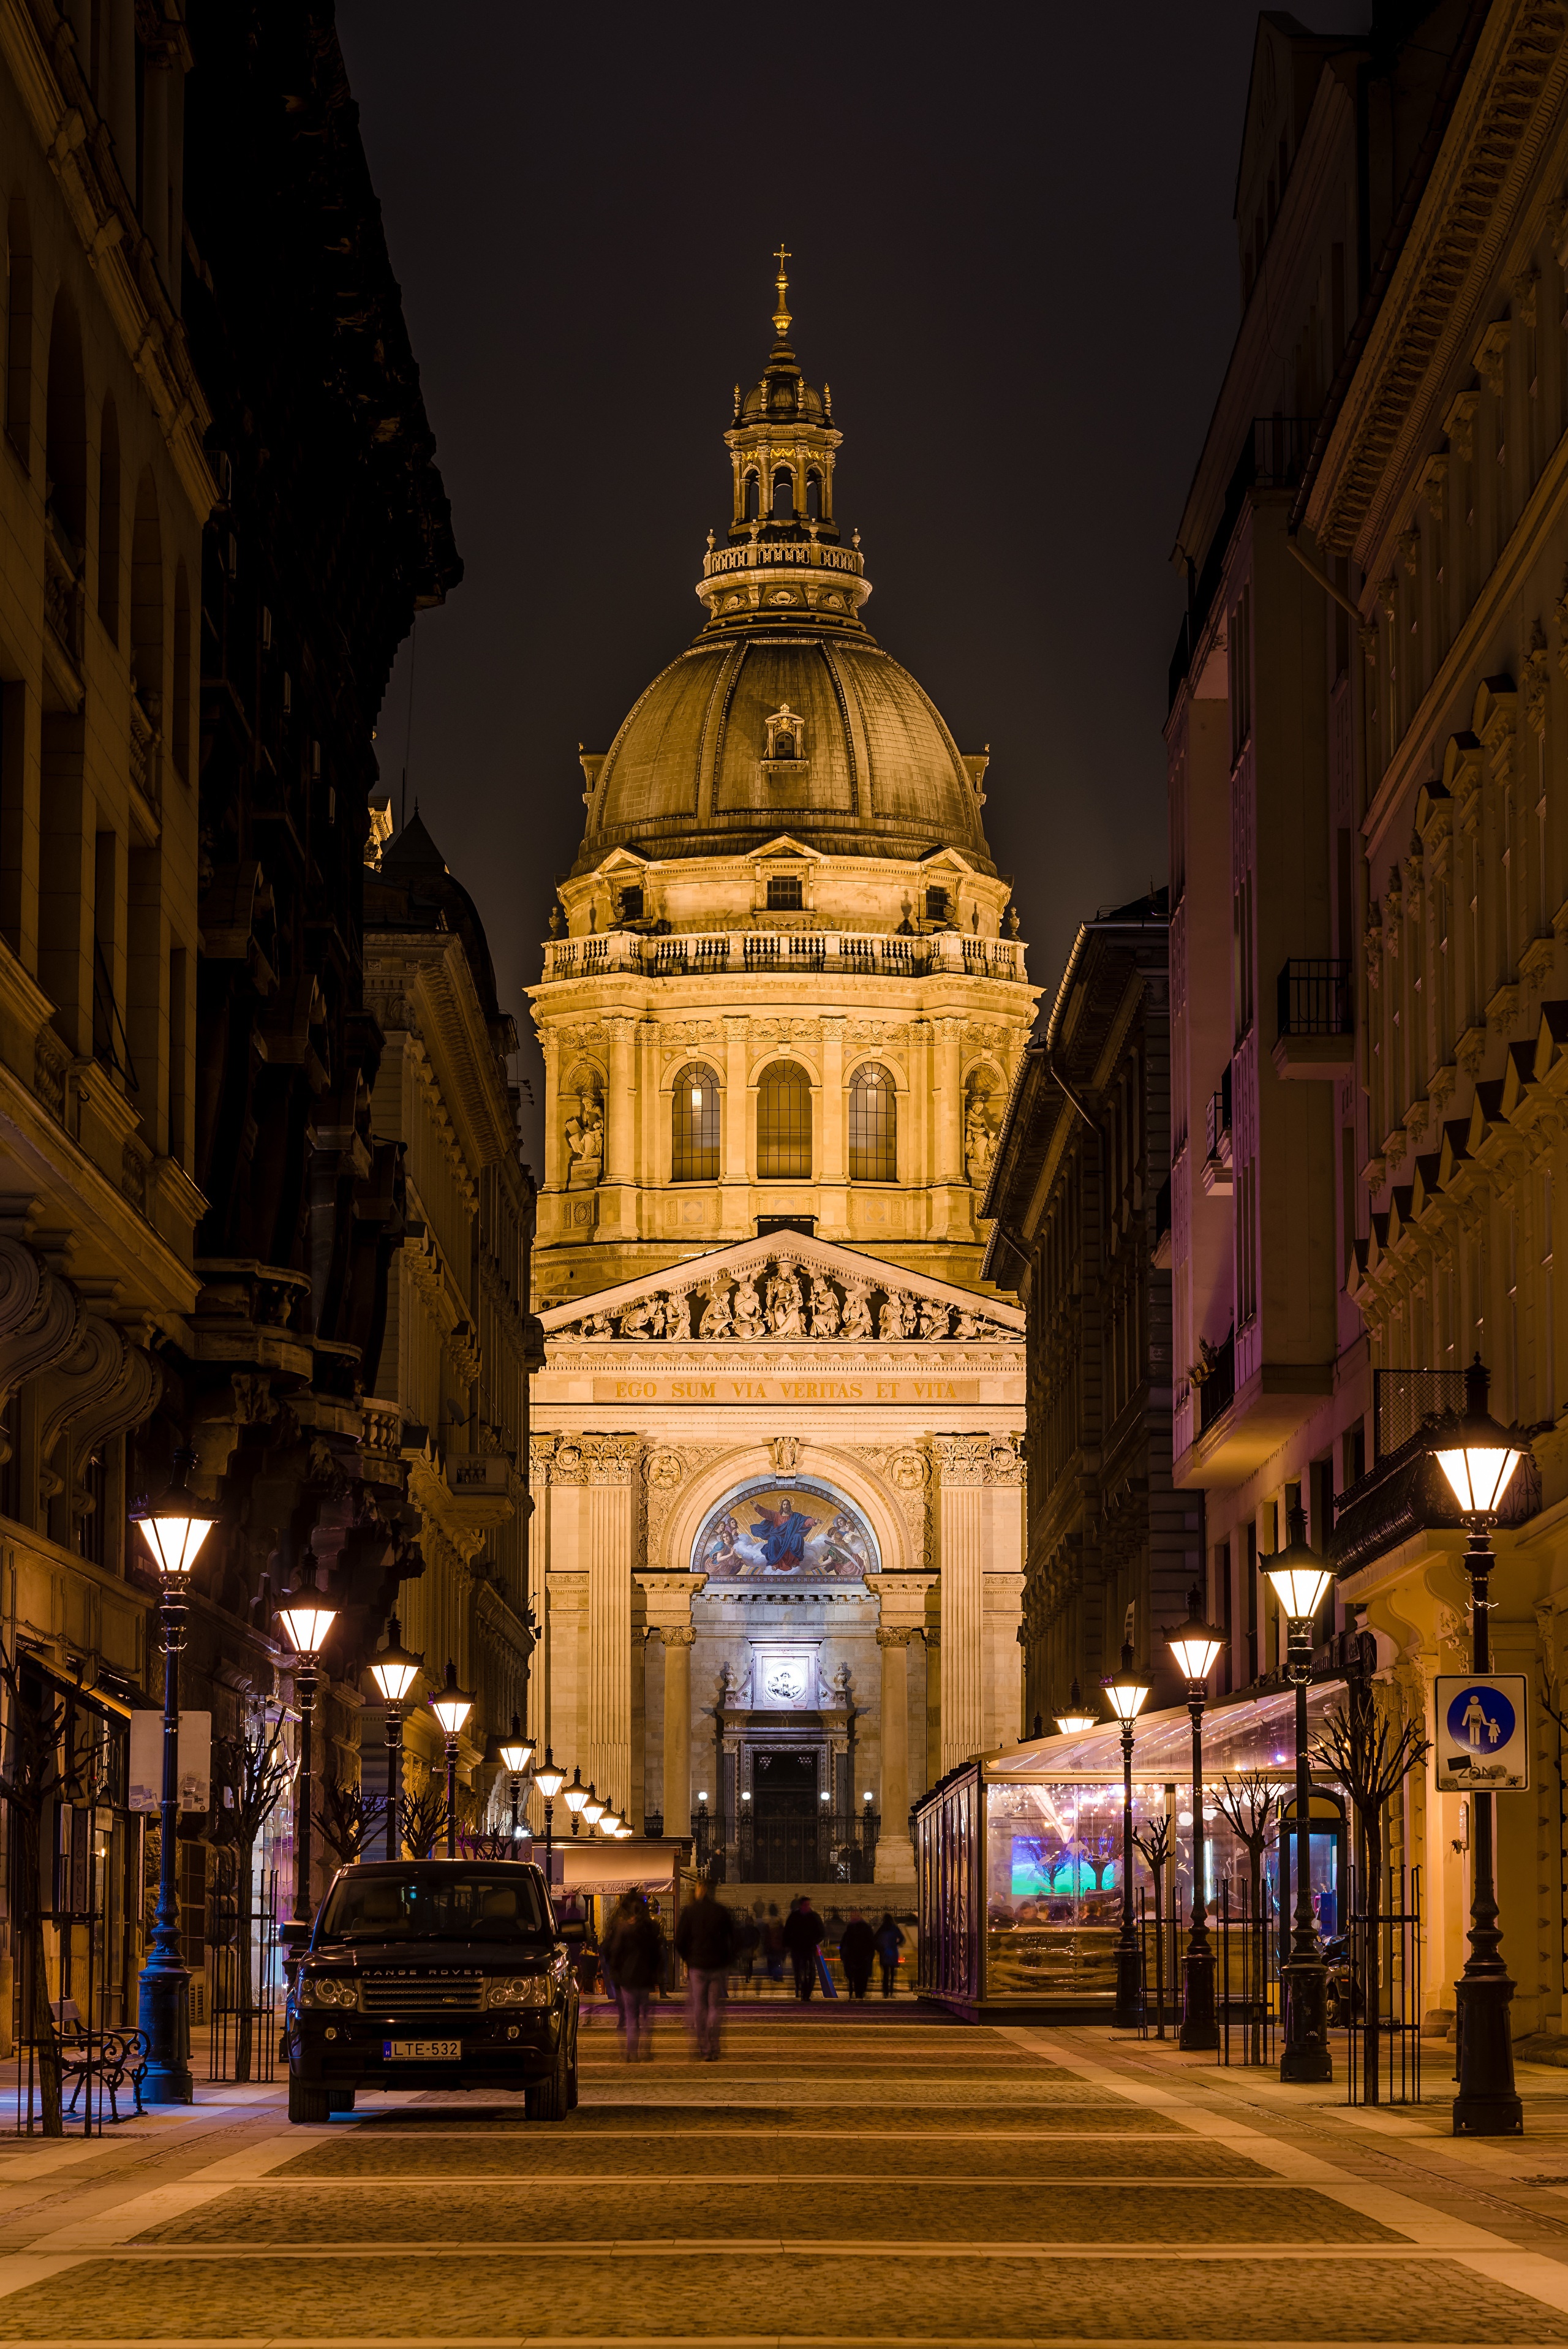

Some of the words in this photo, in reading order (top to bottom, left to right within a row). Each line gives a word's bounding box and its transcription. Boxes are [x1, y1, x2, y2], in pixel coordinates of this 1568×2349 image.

[615, 1382, 657, 1398] EGO
[671, 1382, 717, 1398] SUM
[731, 1382, 768, 1398] VIA
[779, 1382, 863, 1398] VERITAS
[876, 1382, 900, 1398] ET
[913, 1382, 957, 1398] VITA
[394, 2042, 458, 2056] LTE-532
